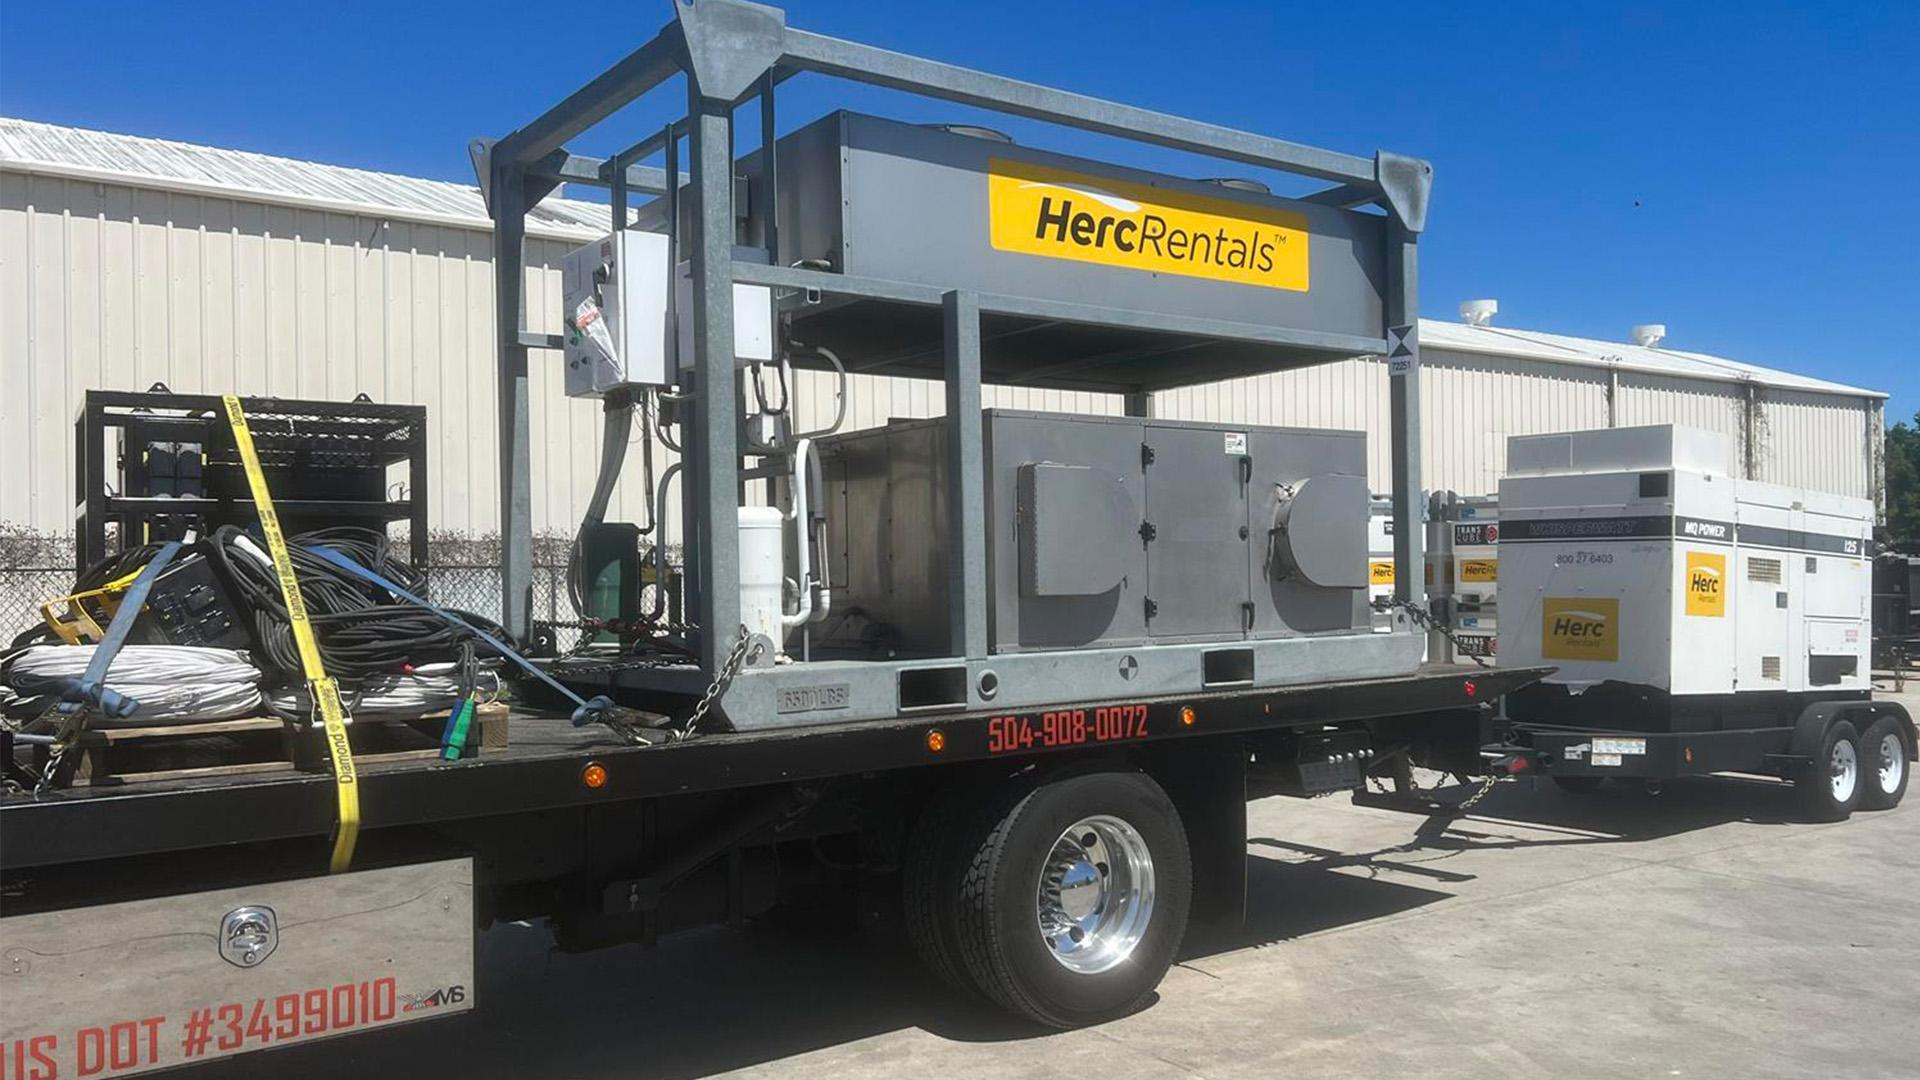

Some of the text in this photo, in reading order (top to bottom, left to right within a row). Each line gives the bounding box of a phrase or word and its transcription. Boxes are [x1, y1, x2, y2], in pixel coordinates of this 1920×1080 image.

[1456, 525, 1481, 534] TRANS
[1684, 521, 1726, 537] MQ POWER
[1844, 540, 1857, 553] 125
[1557, 554, 1573, 564] 800
[1590, 554, 1614, 564] 6403
[1691, 573, 1719, 593] Herc
[1554, 618, 1606, 637] Herc
[988, 704, 1148, 753] 504-908-0072
[329, 733, 354, 785] Diamond
[77, 1016, 166, 1077] DOT
[181, 977, 396, 1057] #3499010
